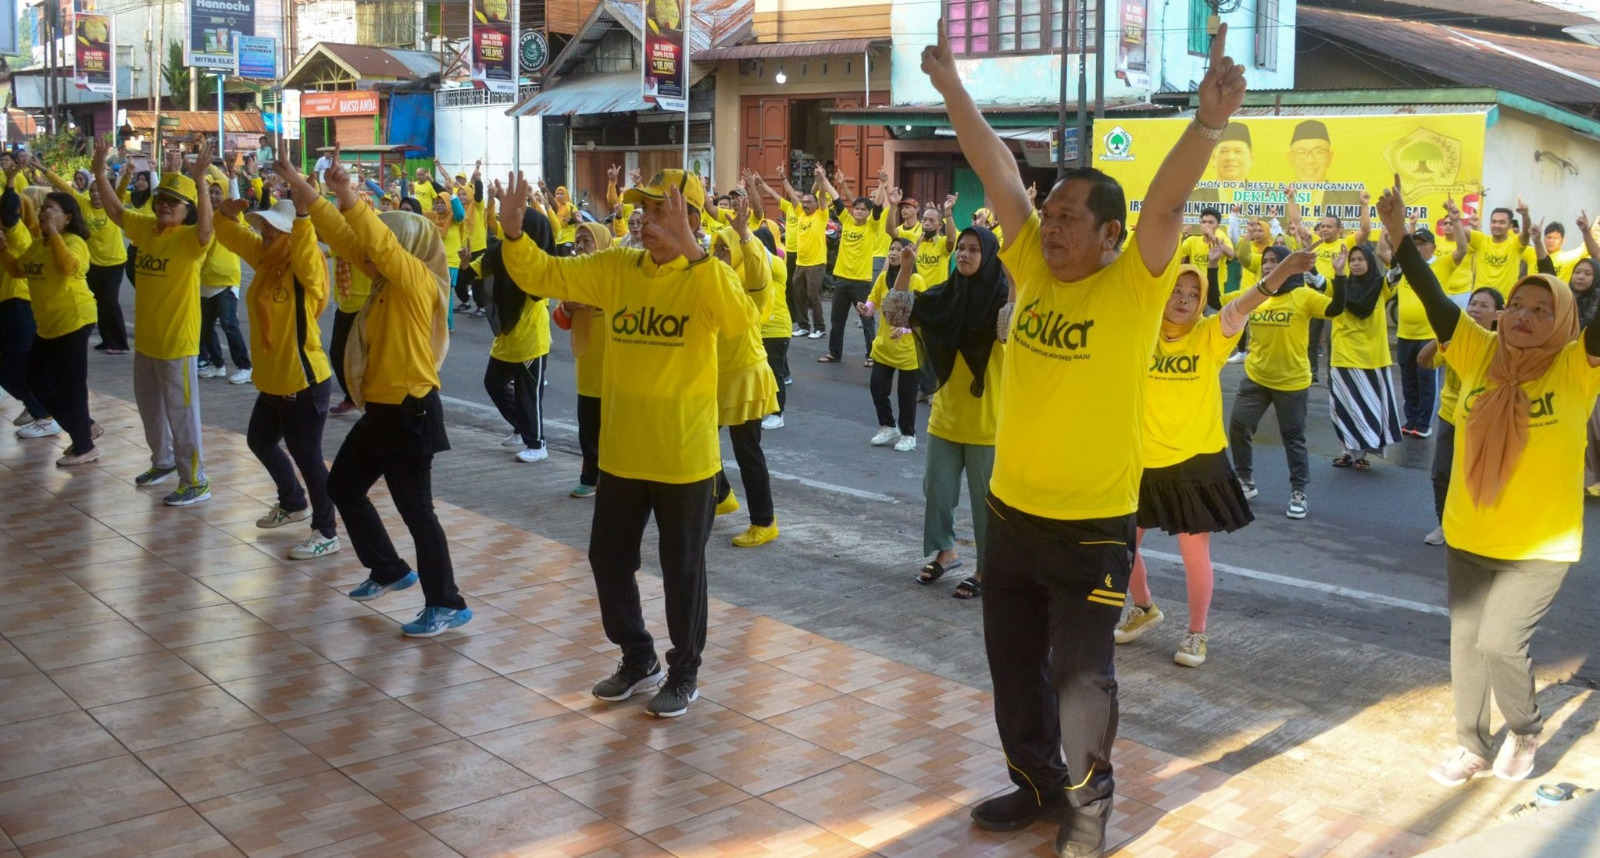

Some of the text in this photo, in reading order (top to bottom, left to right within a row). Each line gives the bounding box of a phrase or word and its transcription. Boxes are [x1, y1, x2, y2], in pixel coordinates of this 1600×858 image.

[196, 0, 251, 12] Hannochs
[340, 101, 359, 113] BAKSO
[360, 99, 377, 111] ANDA
[1195, 180, 1220, 189] OHON
[1247, 182, 1275, 190] RESTU
